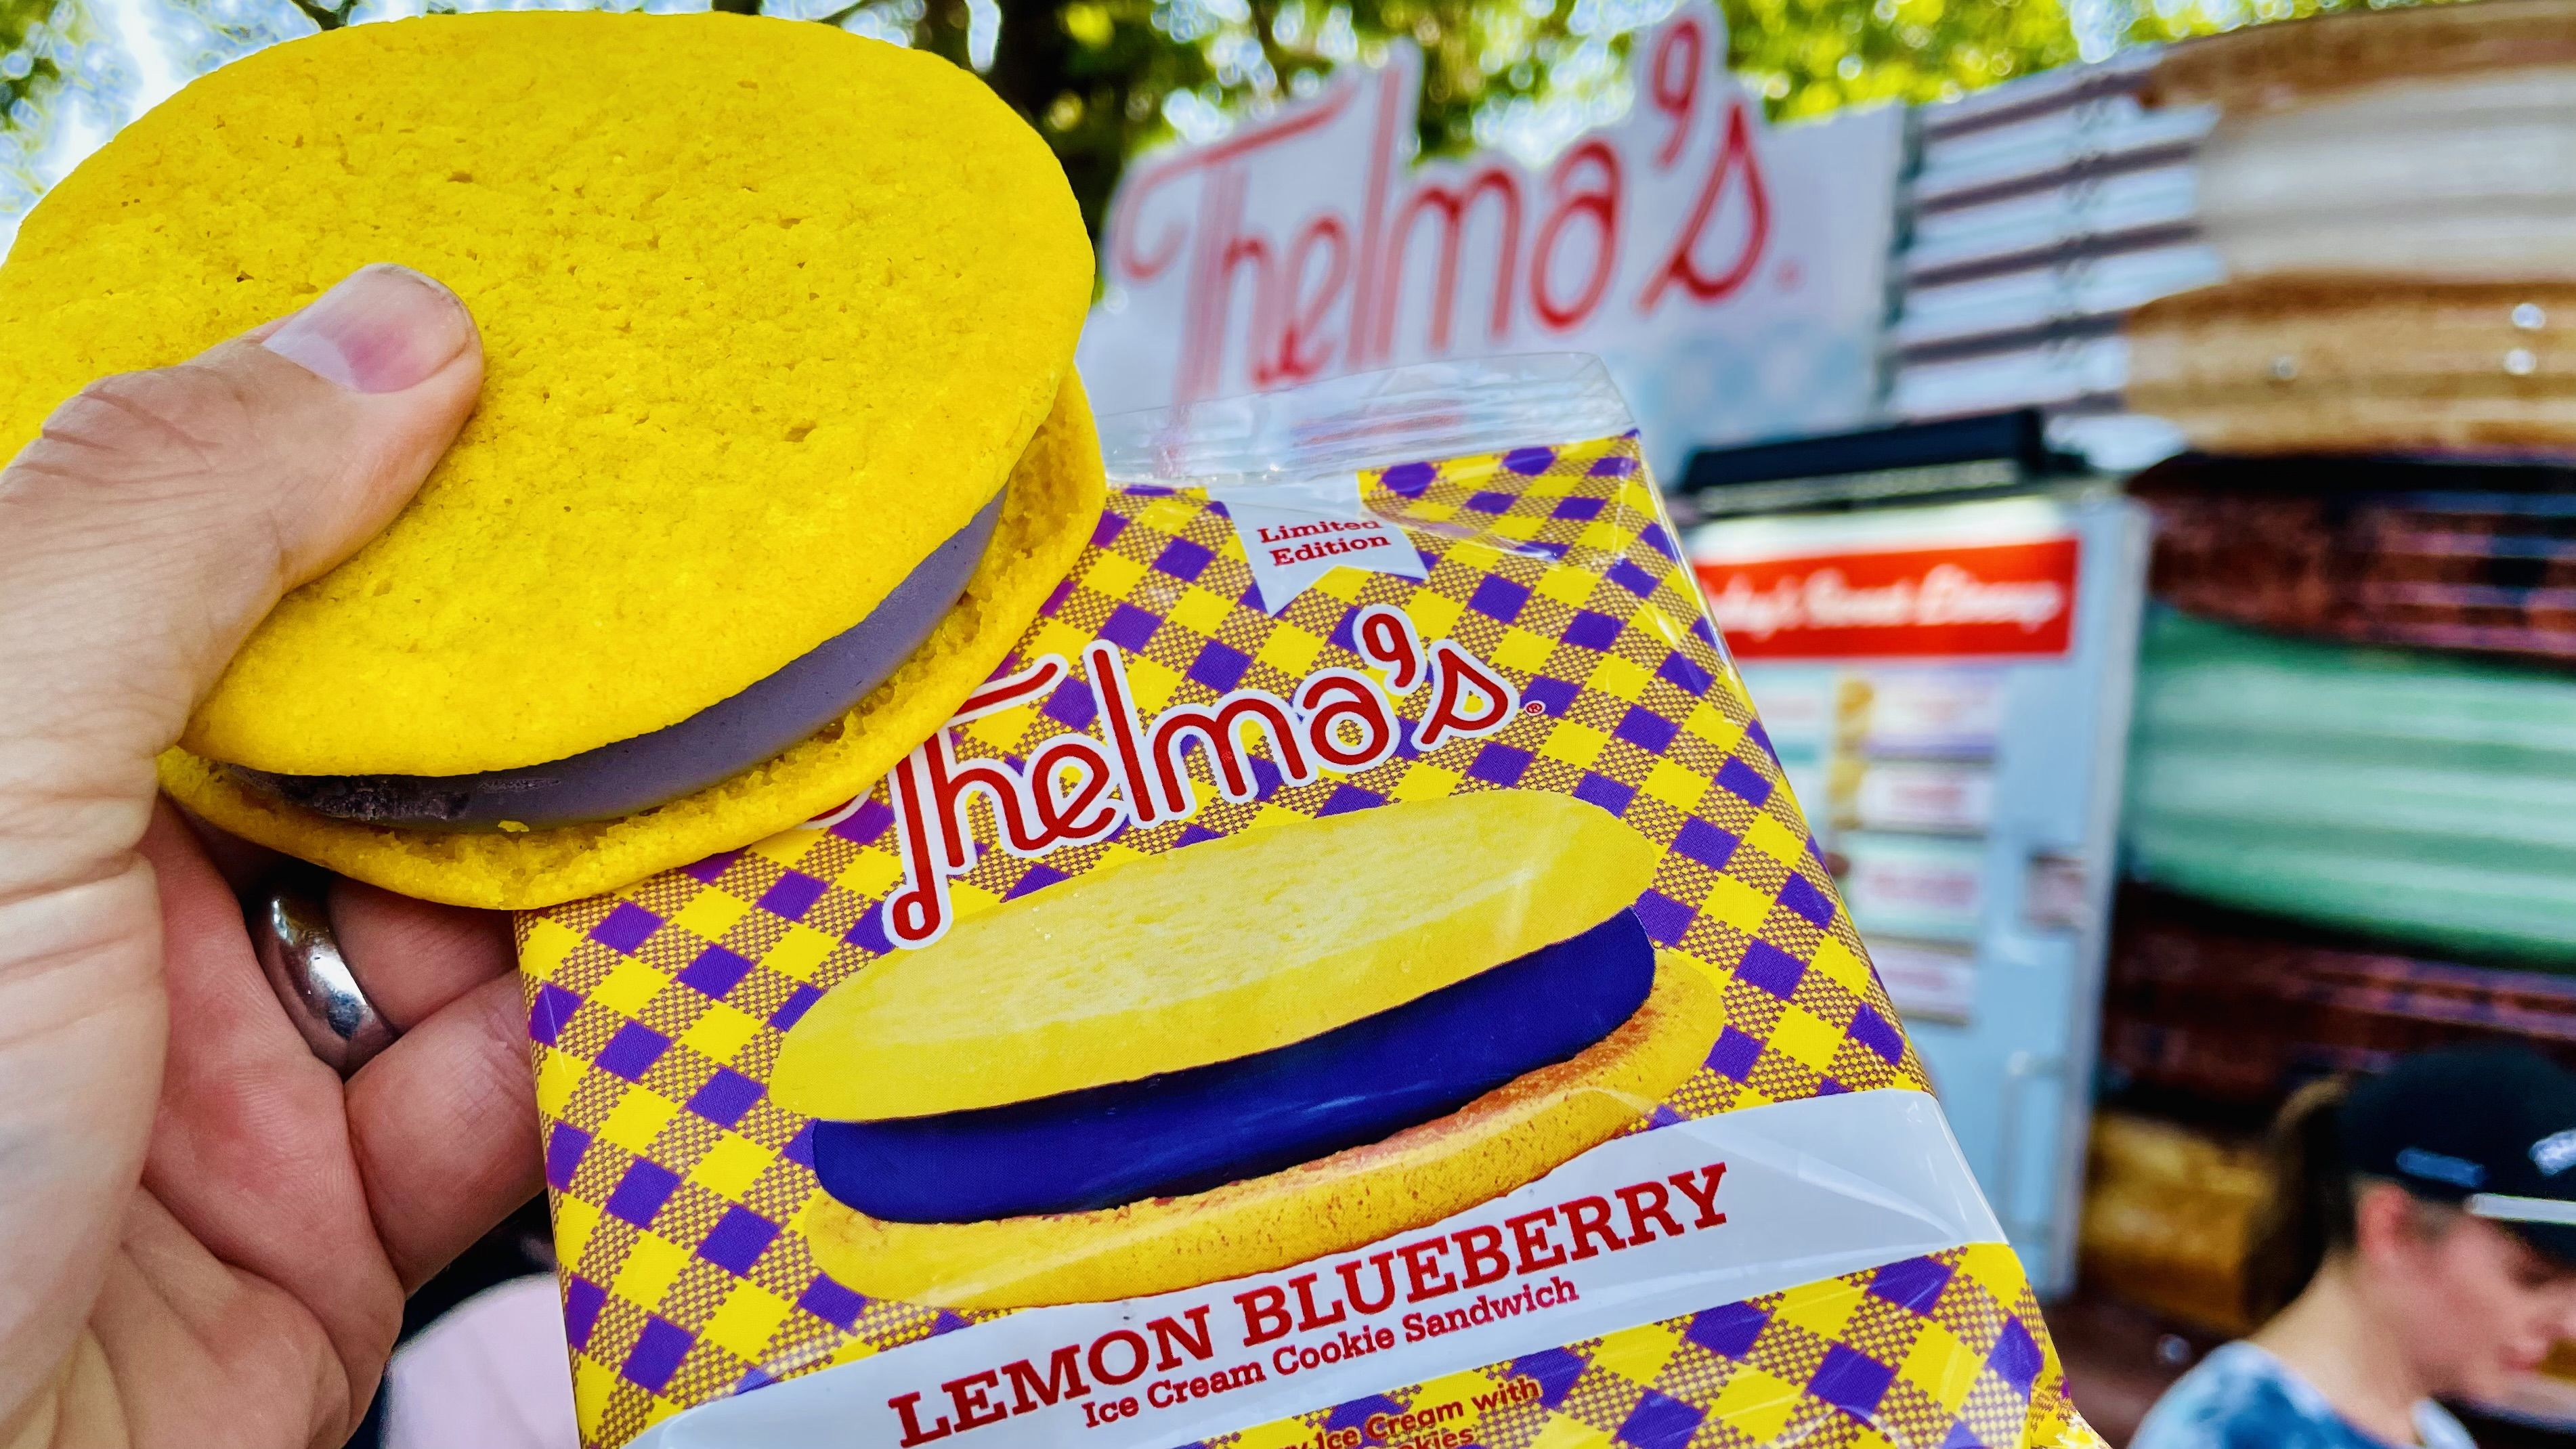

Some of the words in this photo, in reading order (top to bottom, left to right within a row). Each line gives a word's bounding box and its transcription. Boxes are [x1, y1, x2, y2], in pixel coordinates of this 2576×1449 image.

[1112, 18, 1770, 420] Thelma's
[1257, 520, 1383, 544] Limited
[1269, 535, 1391, 567] Edition
[809, 613, 1508, 941] Thelma's
[888, 1304, 1214, 1448] LEMON
[1234, 1162, 1727, 1347] BLUEBERRY
[1082, 1396, 1140, 1429] Ice
[1146, 1360, 1266, 1409] Cream
[1272, 1324, 1395, 1375] Cookie
[1405, 1276, 1580, 1343] Sandwich
[1314, 1429, 1359, 1449] Ice
[1367, 1401, 1464, 1440] Cream
[1471, 1377, 1540, 1411] with
